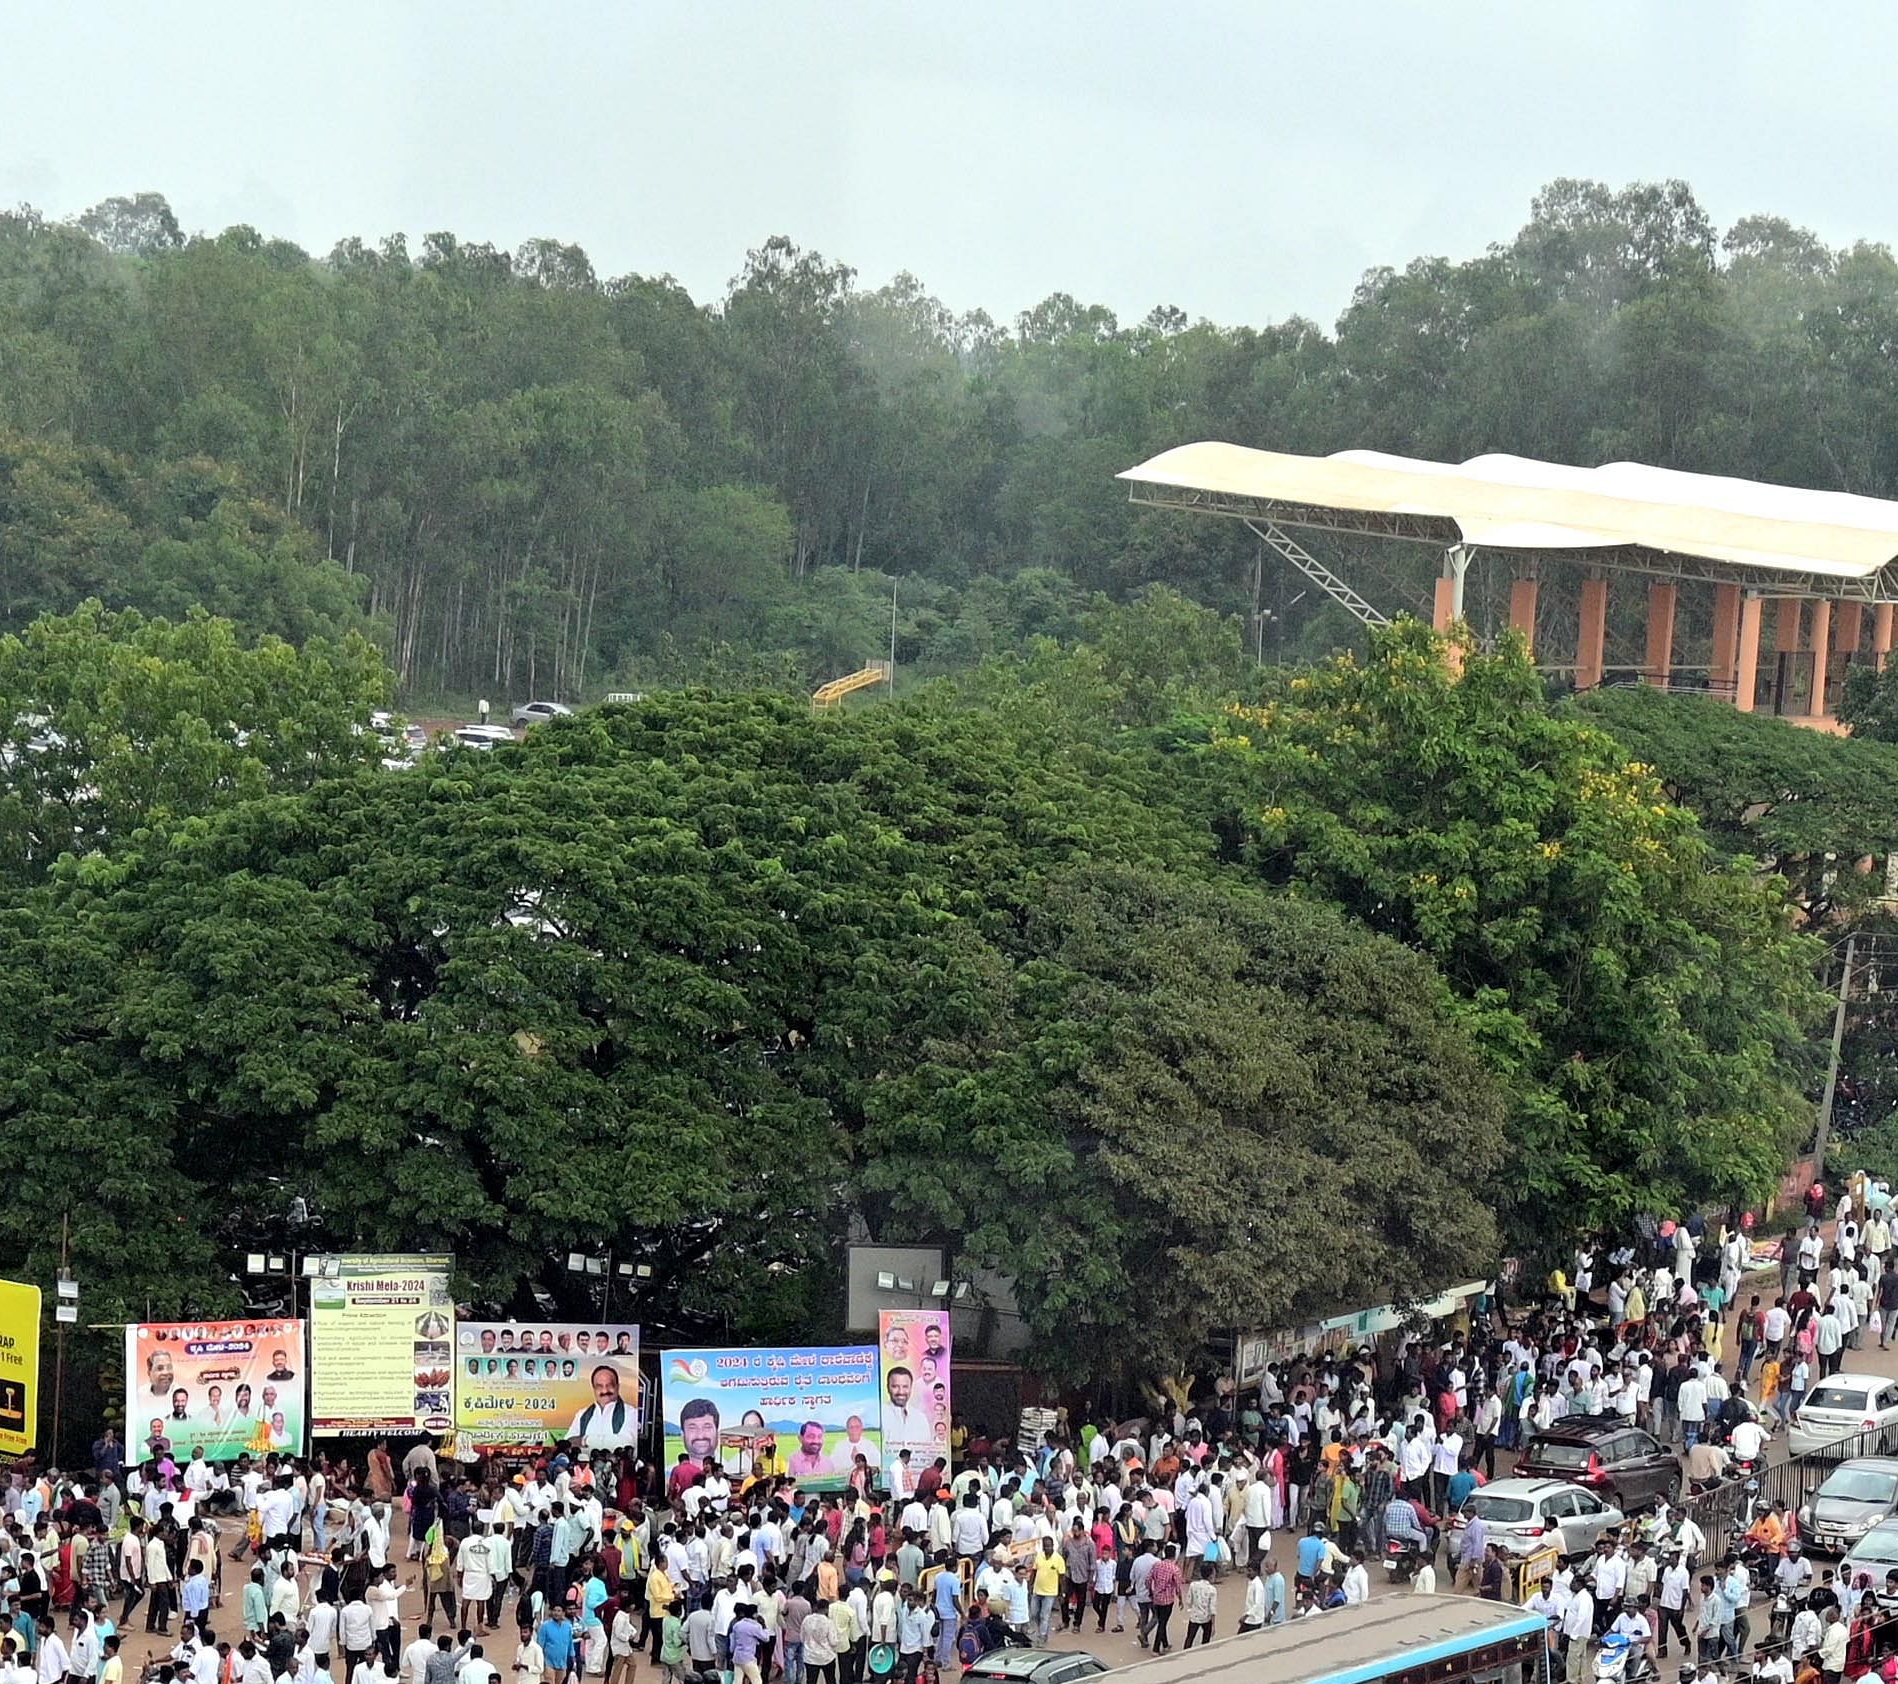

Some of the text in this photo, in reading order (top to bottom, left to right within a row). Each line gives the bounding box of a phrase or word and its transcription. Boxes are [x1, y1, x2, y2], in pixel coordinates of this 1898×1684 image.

[347, 1279, 425, 1291] Krishi Mela-2024
[6, 1352, 23, 1366] Free
[343, 1429, 377, 1437] HEARTY
